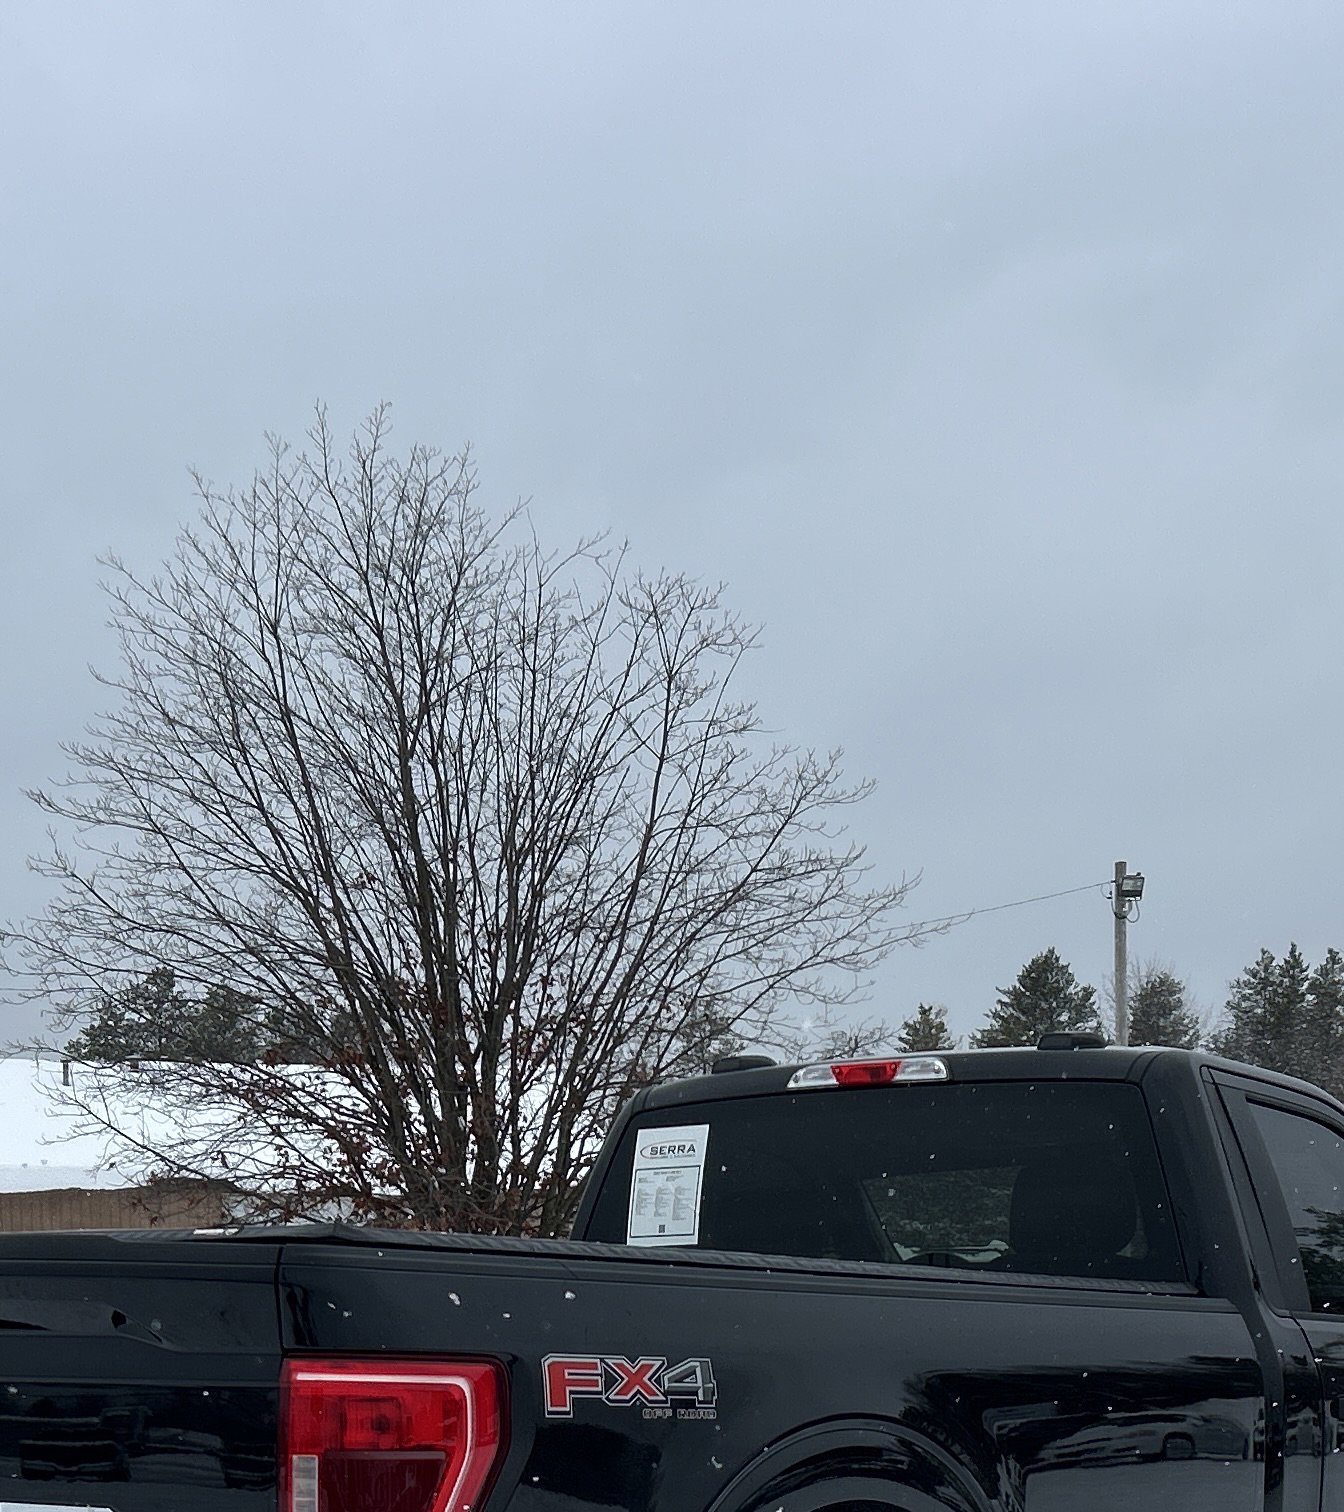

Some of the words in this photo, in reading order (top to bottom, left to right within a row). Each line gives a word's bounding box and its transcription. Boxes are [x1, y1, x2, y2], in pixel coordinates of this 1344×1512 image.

[649, 1143, 696, 1156] SERRA
[540, 1352, 718, 1418] FX4
[642, 1408, 673, 1419] OFF
[676, 1408, 717, 1420] ROAD
